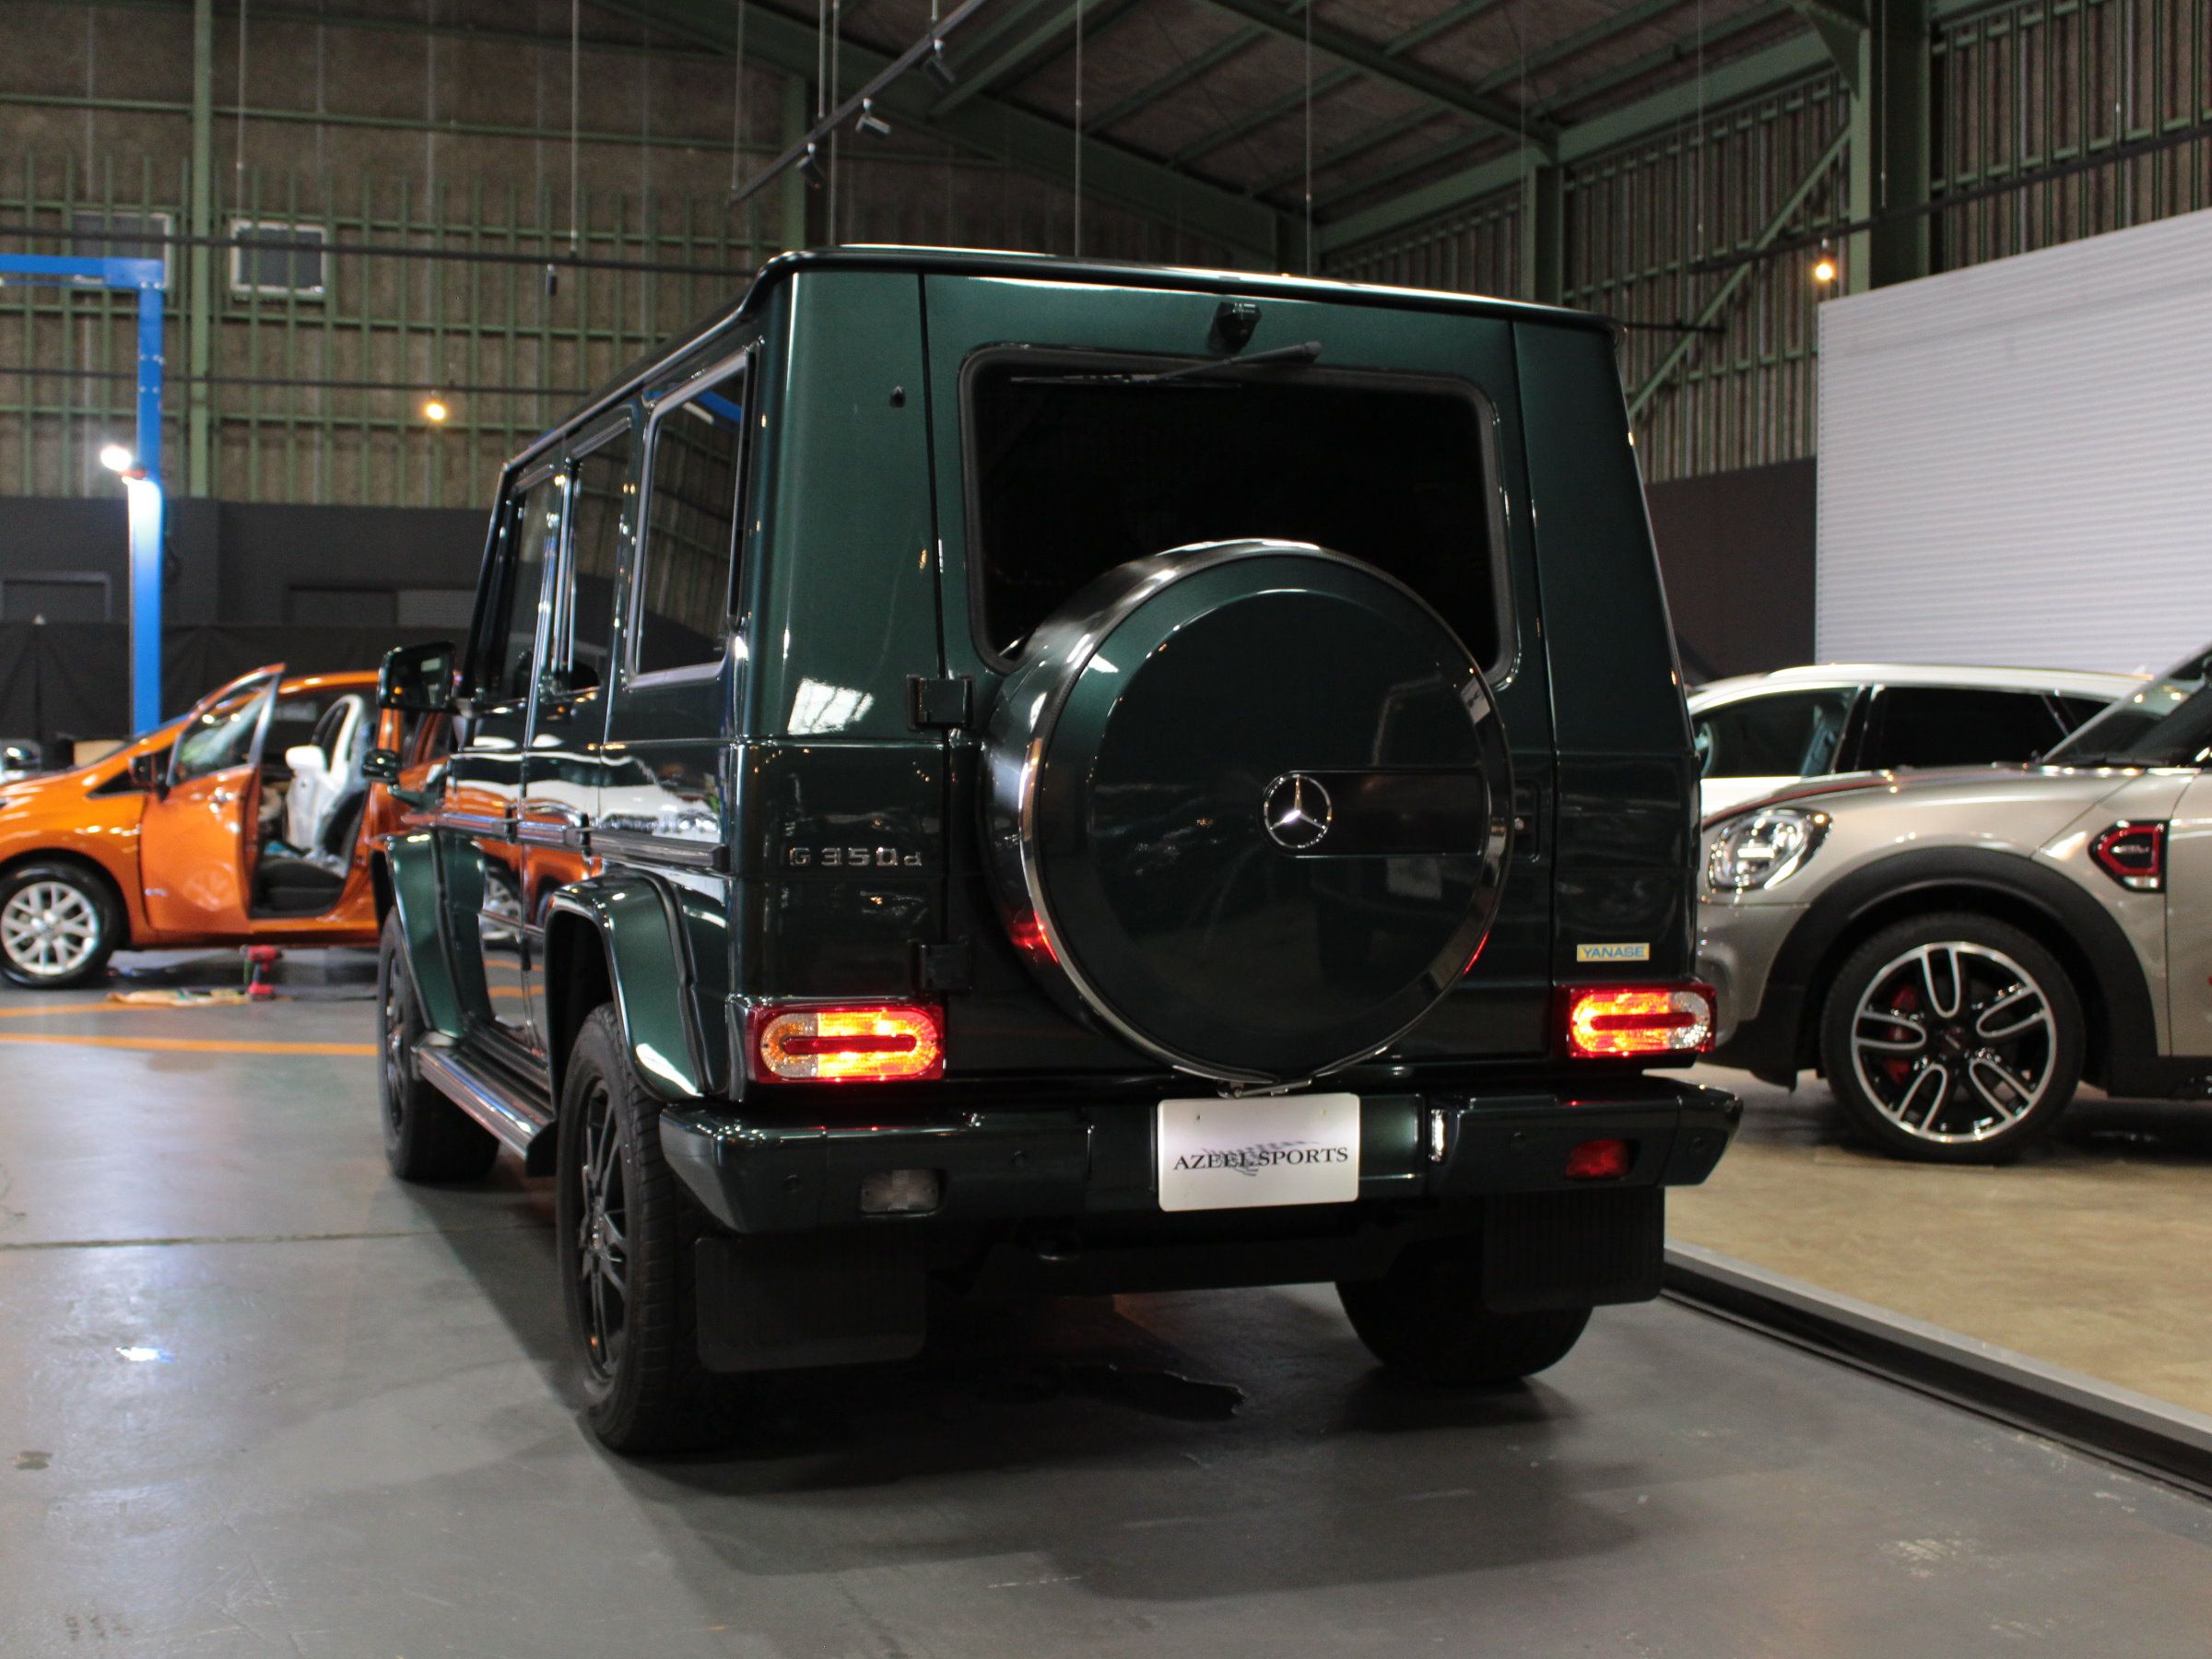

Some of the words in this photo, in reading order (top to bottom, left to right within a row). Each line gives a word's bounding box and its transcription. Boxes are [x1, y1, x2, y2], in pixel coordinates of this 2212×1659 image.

[789, 847, 811, 866] G
[1583, 947, 1644, 959] YANASE
[1256, 1147, 1348, 1167] SPORTS
